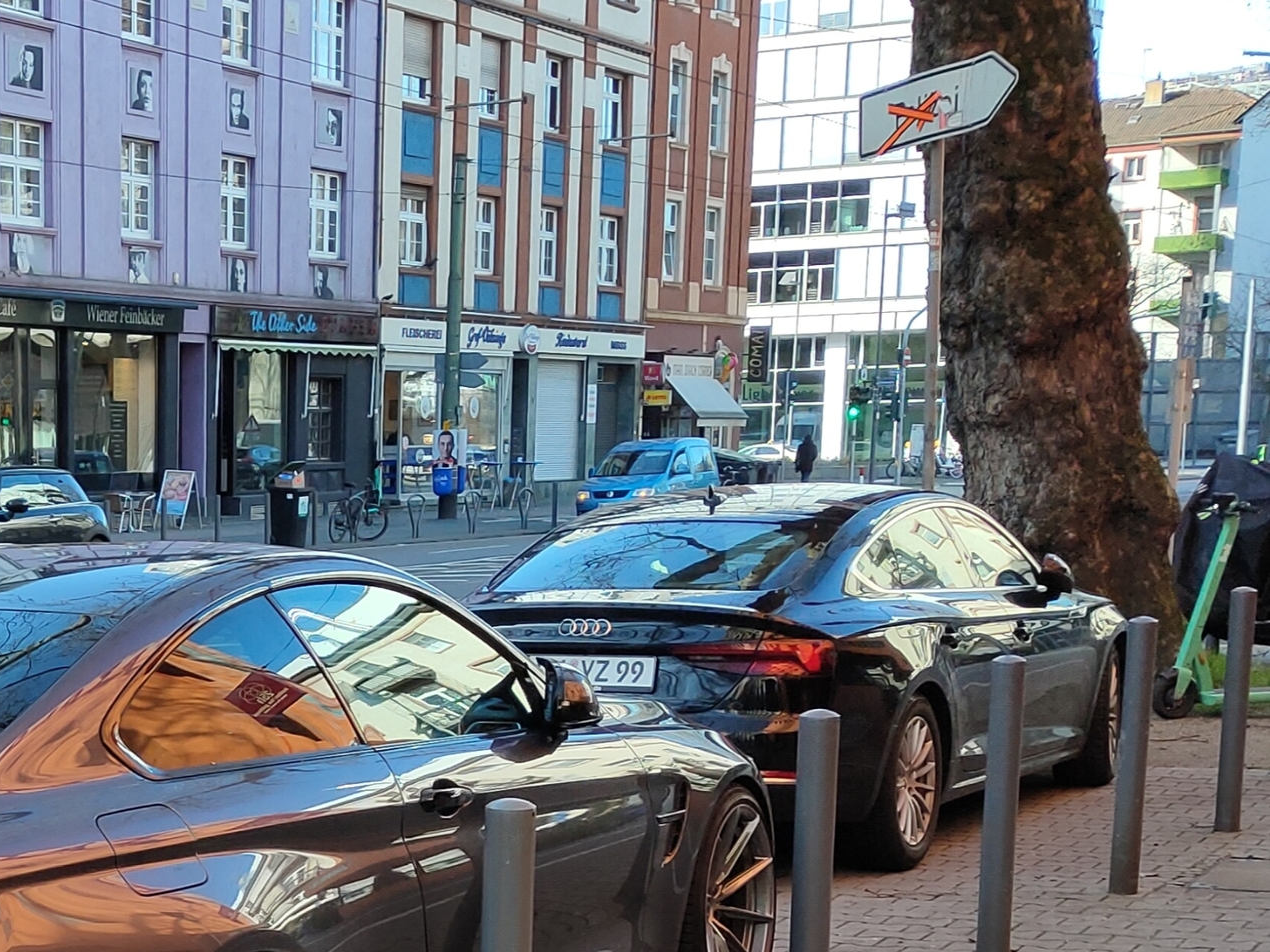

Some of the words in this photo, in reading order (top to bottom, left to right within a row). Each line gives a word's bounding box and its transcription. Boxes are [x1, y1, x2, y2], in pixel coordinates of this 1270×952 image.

[86, 303, 118, 323] Wiener
[119, 306, 165, 326] Feinbäcker
[249, 310, 266, 331] The
[268, 312, 293, 332] Other
[295, 313, 318, 334] Side
[401, 327, 443, 340] FLEISCHEREI
[616, 660, 645, 683] 99
